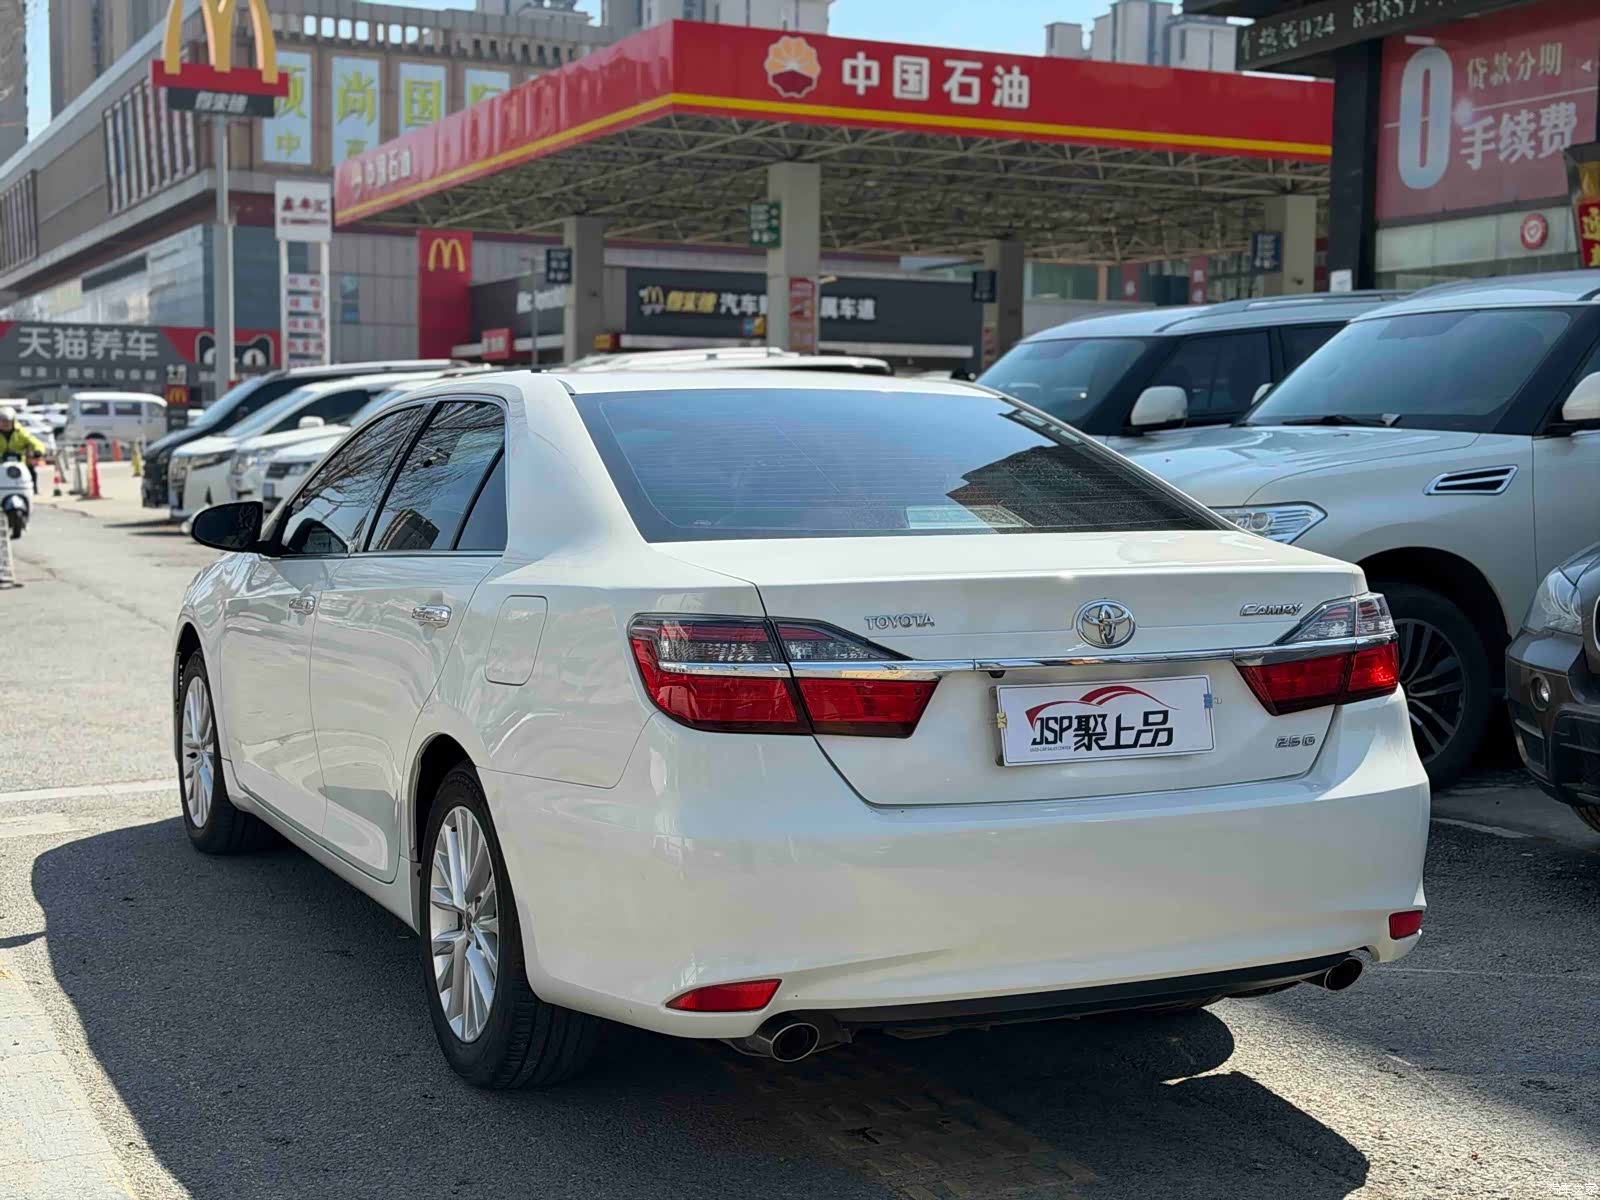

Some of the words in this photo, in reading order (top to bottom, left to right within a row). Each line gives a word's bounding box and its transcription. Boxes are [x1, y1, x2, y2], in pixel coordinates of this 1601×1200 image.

[842, 51, 1030, 109] 中国石油
[1467, 43, 1563, 89] 贷款分期
[1397, 46, 1453, 190] 0
[1460, 101, 1577, 171] 手续费
[18, 327, 159, 361] 天猫养车
[864, 613, 936, 631] TOYOTA
